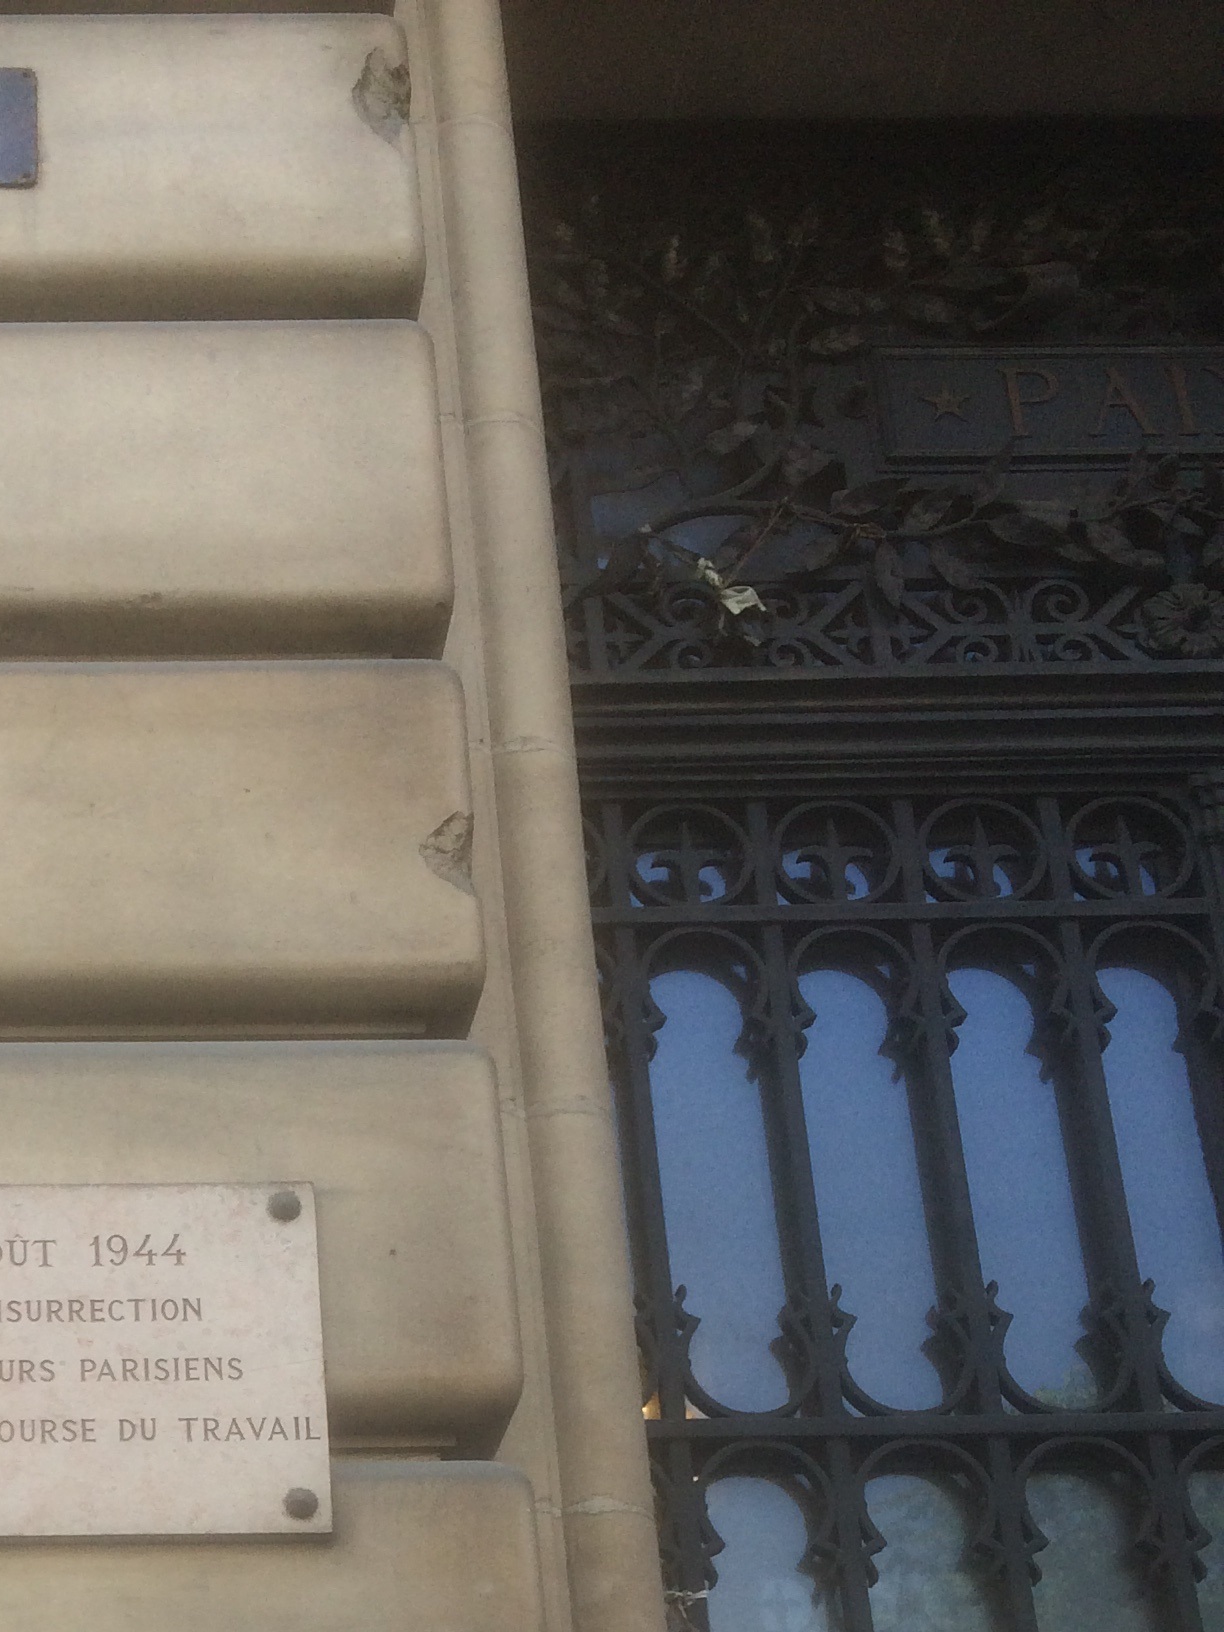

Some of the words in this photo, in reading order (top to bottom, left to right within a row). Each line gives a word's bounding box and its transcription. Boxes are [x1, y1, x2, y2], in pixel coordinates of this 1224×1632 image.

[90, 1233, 188, 1267] 1944
[79, 1356, 244, 1383] PARISIENS
[118, 1418, 157, 1443] DU
[178, 1416, 321, 1442] TRAVAIL
